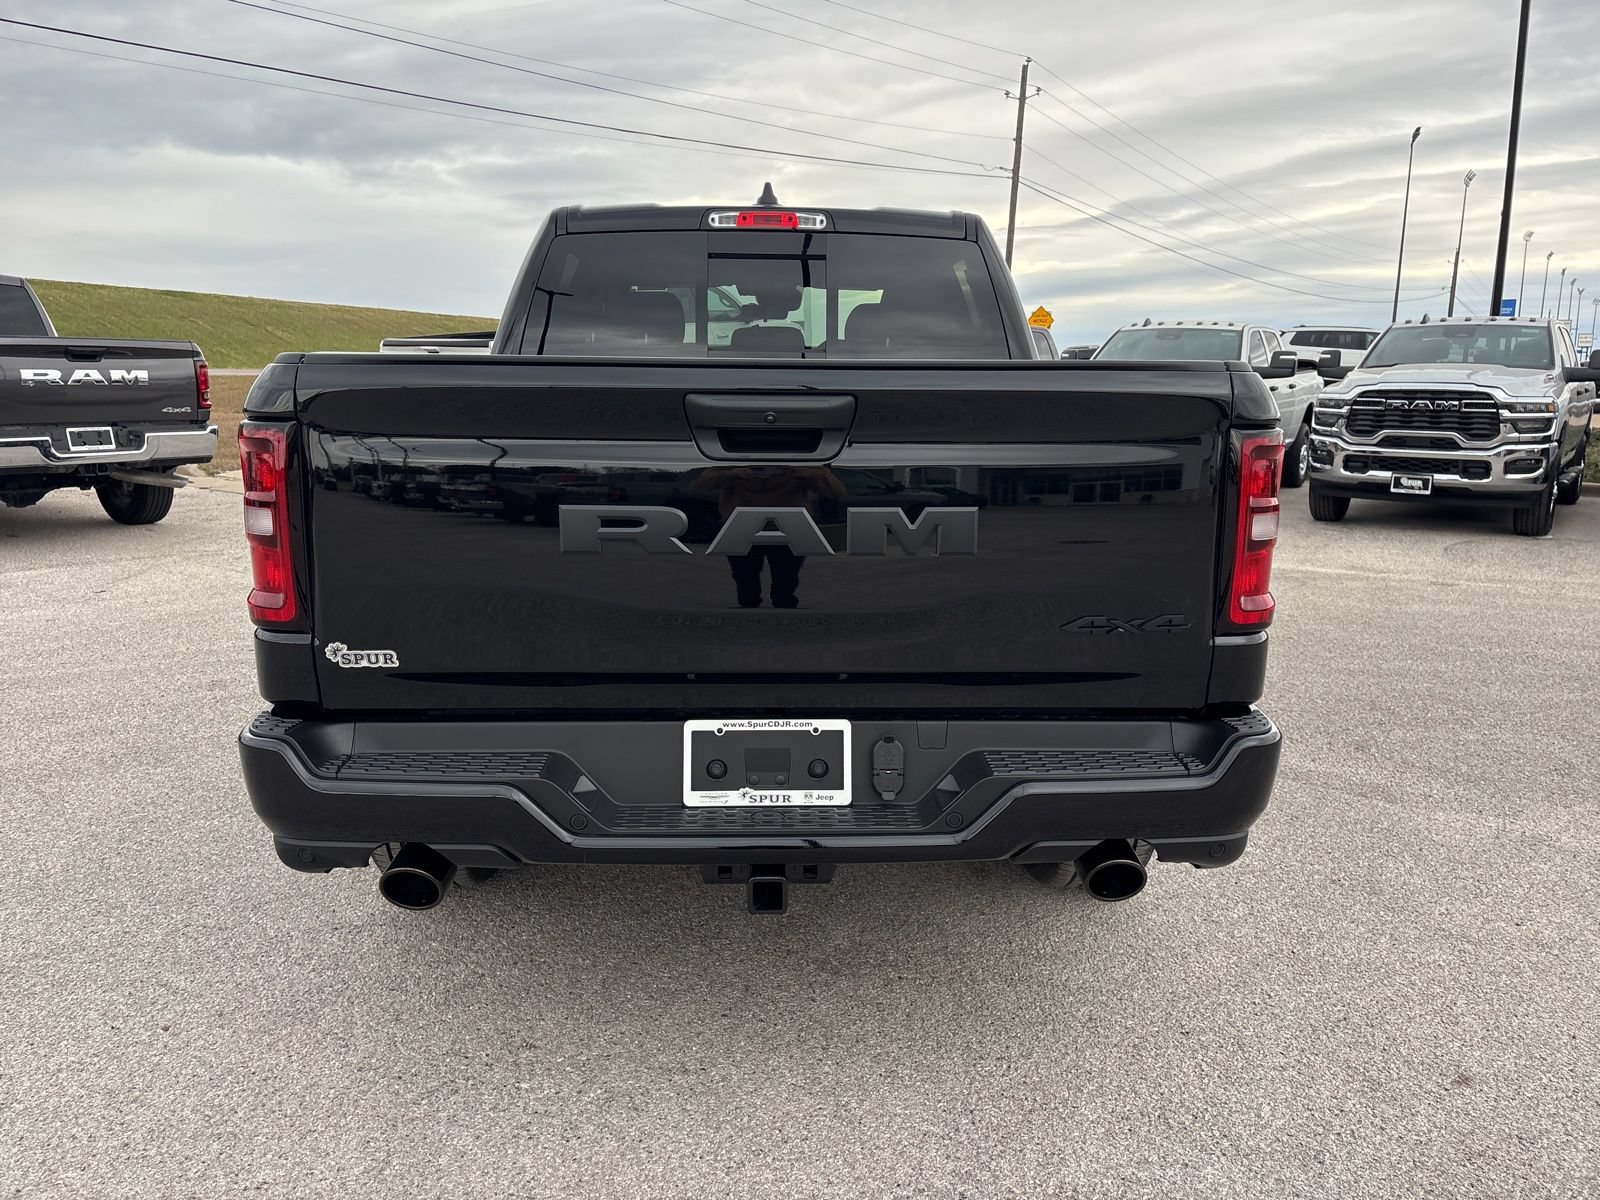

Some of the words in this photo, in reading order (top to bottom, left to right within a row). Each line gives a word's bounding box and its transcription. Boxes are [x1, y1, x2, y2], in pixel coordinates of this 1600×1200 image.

[19, 368, 150, 386] RAM
[161, 406, 192, 414] 4x4
[1386, 400, 1460, 410] RAM
[558, 504, 979, 556] RAM
[1058, 613, 1194, 633] 4x4
[340, 652, 398, 666] SPUR
[722, 720, 813, 729] www.SpurCDJR.com
[748, 794, 793, 804] SPUR
[815, 793, 834, 802] Jeep
